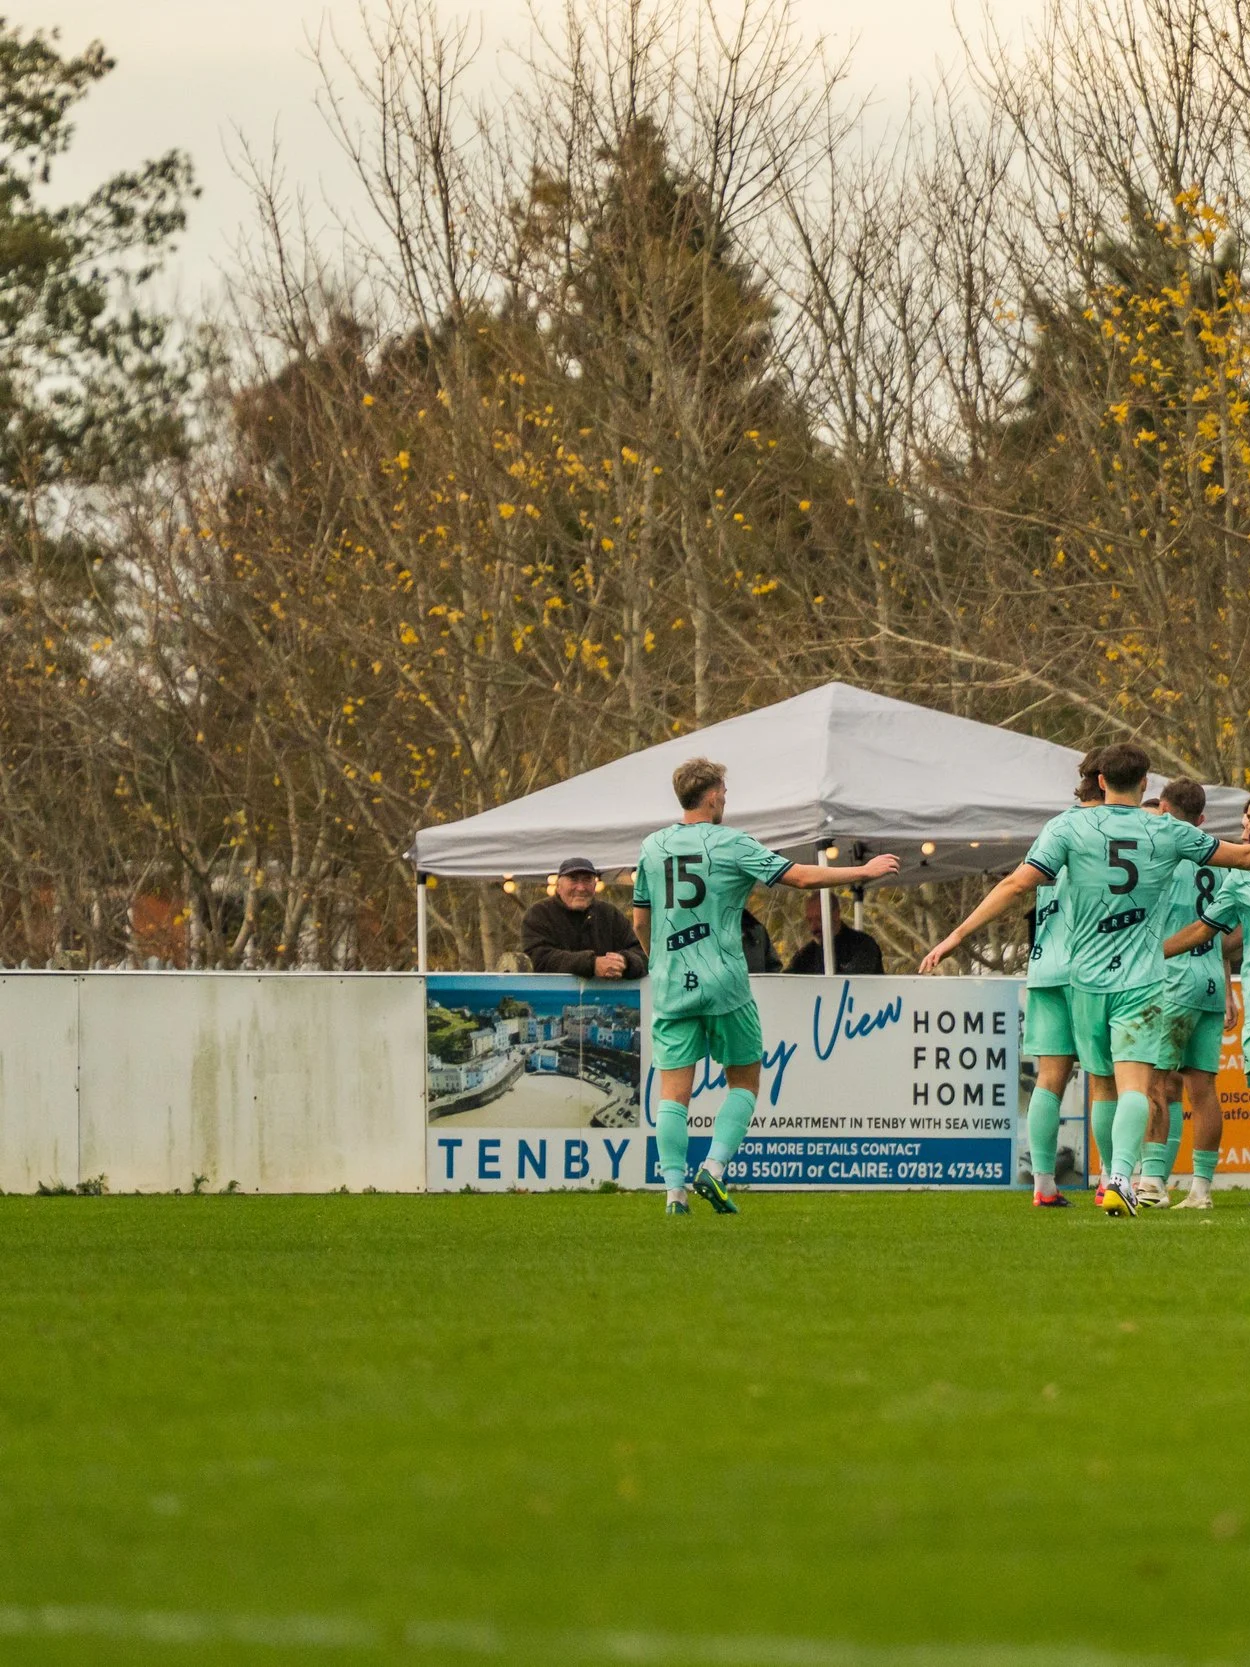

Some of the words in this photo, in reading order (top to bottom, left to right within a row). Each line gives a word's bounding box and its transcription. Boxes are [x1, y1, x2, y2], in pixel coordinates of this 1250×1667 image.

[1108, 840, 1139, 895] 5
[664, 854, 706, 909] 15
[1195, 868, 1216, 918] 8
[1100, 910, 1143, 932] IREN
[668, 926, 706, 949] IREN
[813, 979, 902, 1061] View
[913, 1010, 1006, 1035] HOME
[913, 1046, 1006, 1070] FROM
[912, 1082, 1006, 1106] HOME
[770, 1117, 846, 1129] APARTMENT
[850, 1117, 863, 1129] IN
[867, 1117, 906, 1129] TENBY
[910, 1118, 943, 1130] WITH
[945, 1118, 968, 1130] SEA
[972, 1118, 1010, 1130] VIEWS
[438, 1138, 630, 1179] TENBY
[738, 1142, 763, 1155] FOR
[766, 1143, 803, 1155] MORE
[807, 1143, 857, 1155] DETAILS
[861, 1143, 921, 1156] CONTACT
[752, 1162, 802, 1178] 550171
[807, 1165, 824, 1178] or
[828, 1162, 893, 1178] CLAIRE:
[898, 1162, 943, 1178] 07812
[948, 1162, 1003, 1179] 473435
